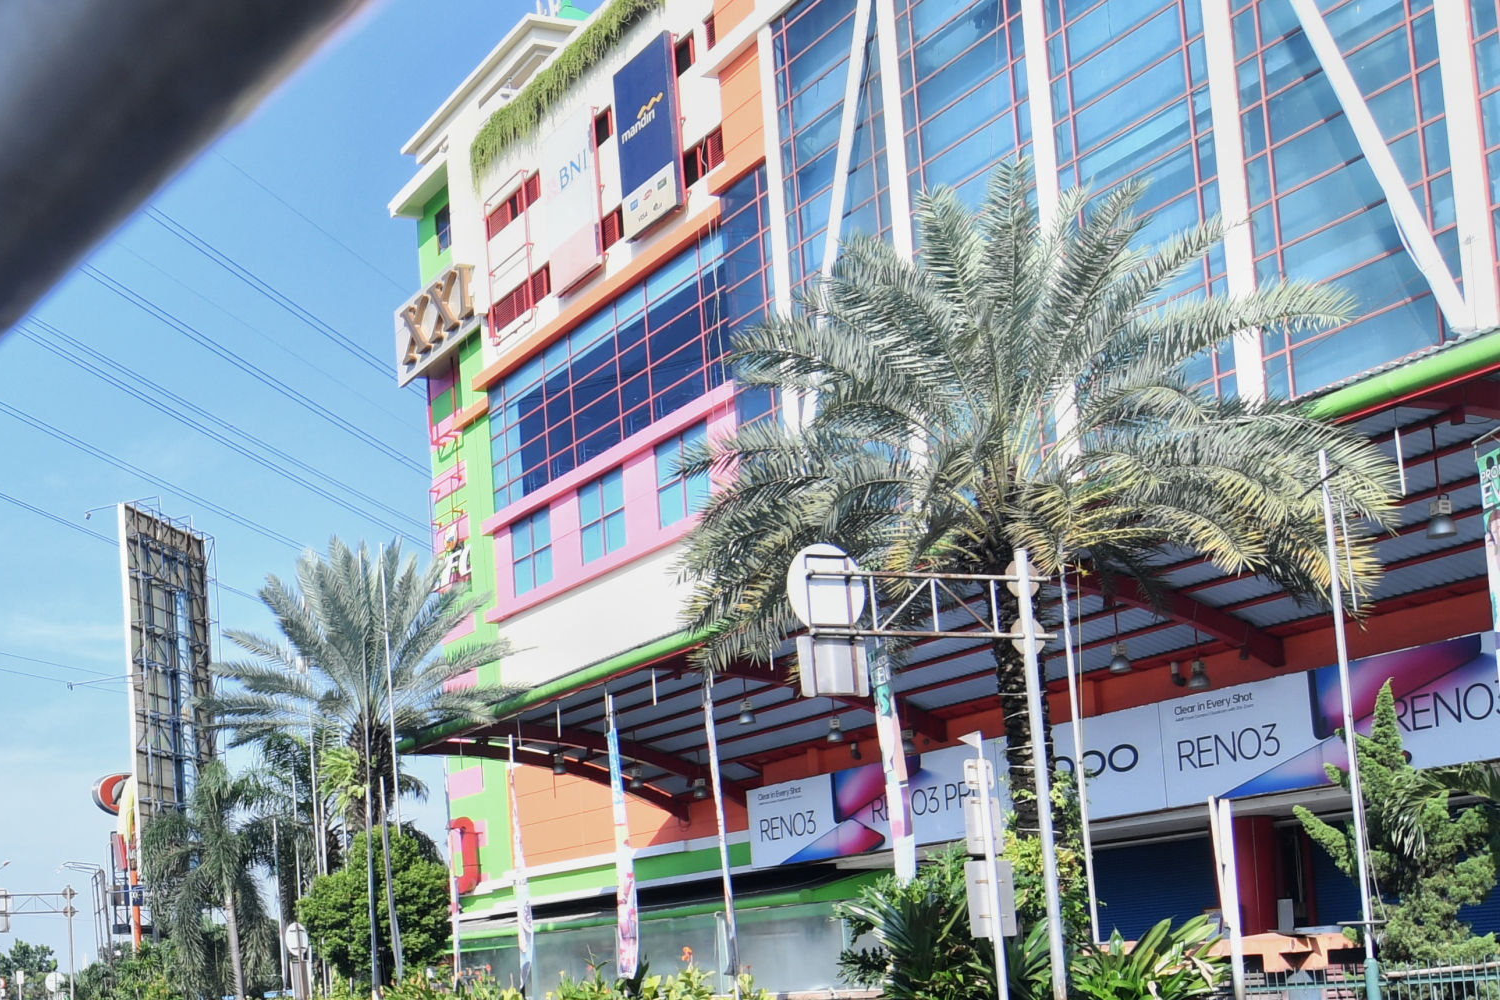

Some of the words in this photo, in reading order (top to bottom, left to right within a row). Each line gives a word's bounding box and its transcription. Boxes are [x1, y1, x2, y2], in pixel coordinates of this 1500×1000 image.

[558, 148, 588, 191] BNI
[400, 263, 476, 367] XXI
[1174, 705, 1196, 715] Clear
[1197, 702, 1206, 711] in
[1206, 697, 1231, 709] Every
[1232, 692, 1253, 704] Shot
[1177, 722, 1281, 772] RENO3
[759, 810, 817, 842] RENO3
